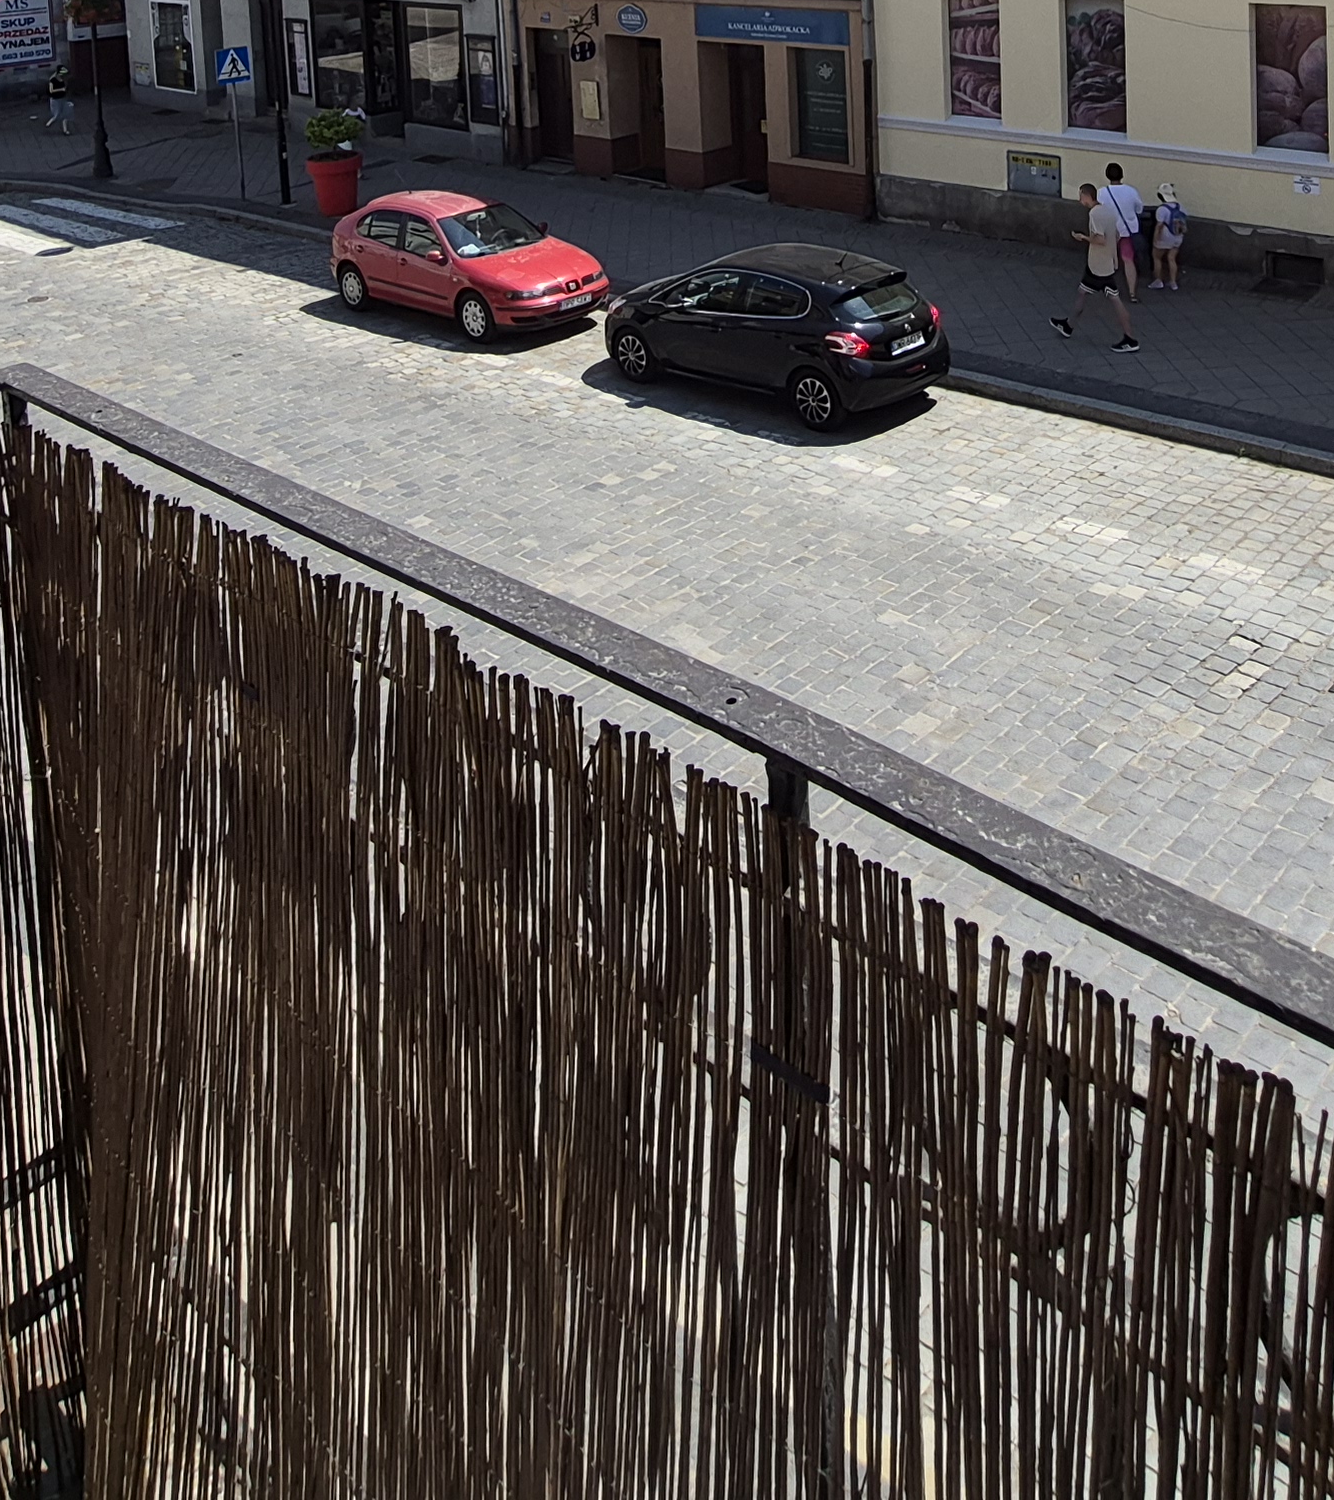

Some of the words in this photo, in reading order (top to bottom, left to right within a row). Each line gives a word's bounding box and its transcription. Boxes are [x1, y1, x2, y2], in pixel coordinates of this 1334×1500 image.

[0, 17, 36, 28] SKUP
[727, 22, 768, 32] KANCELARIA
[768, 23, 811, 34] ADWOKACKA
